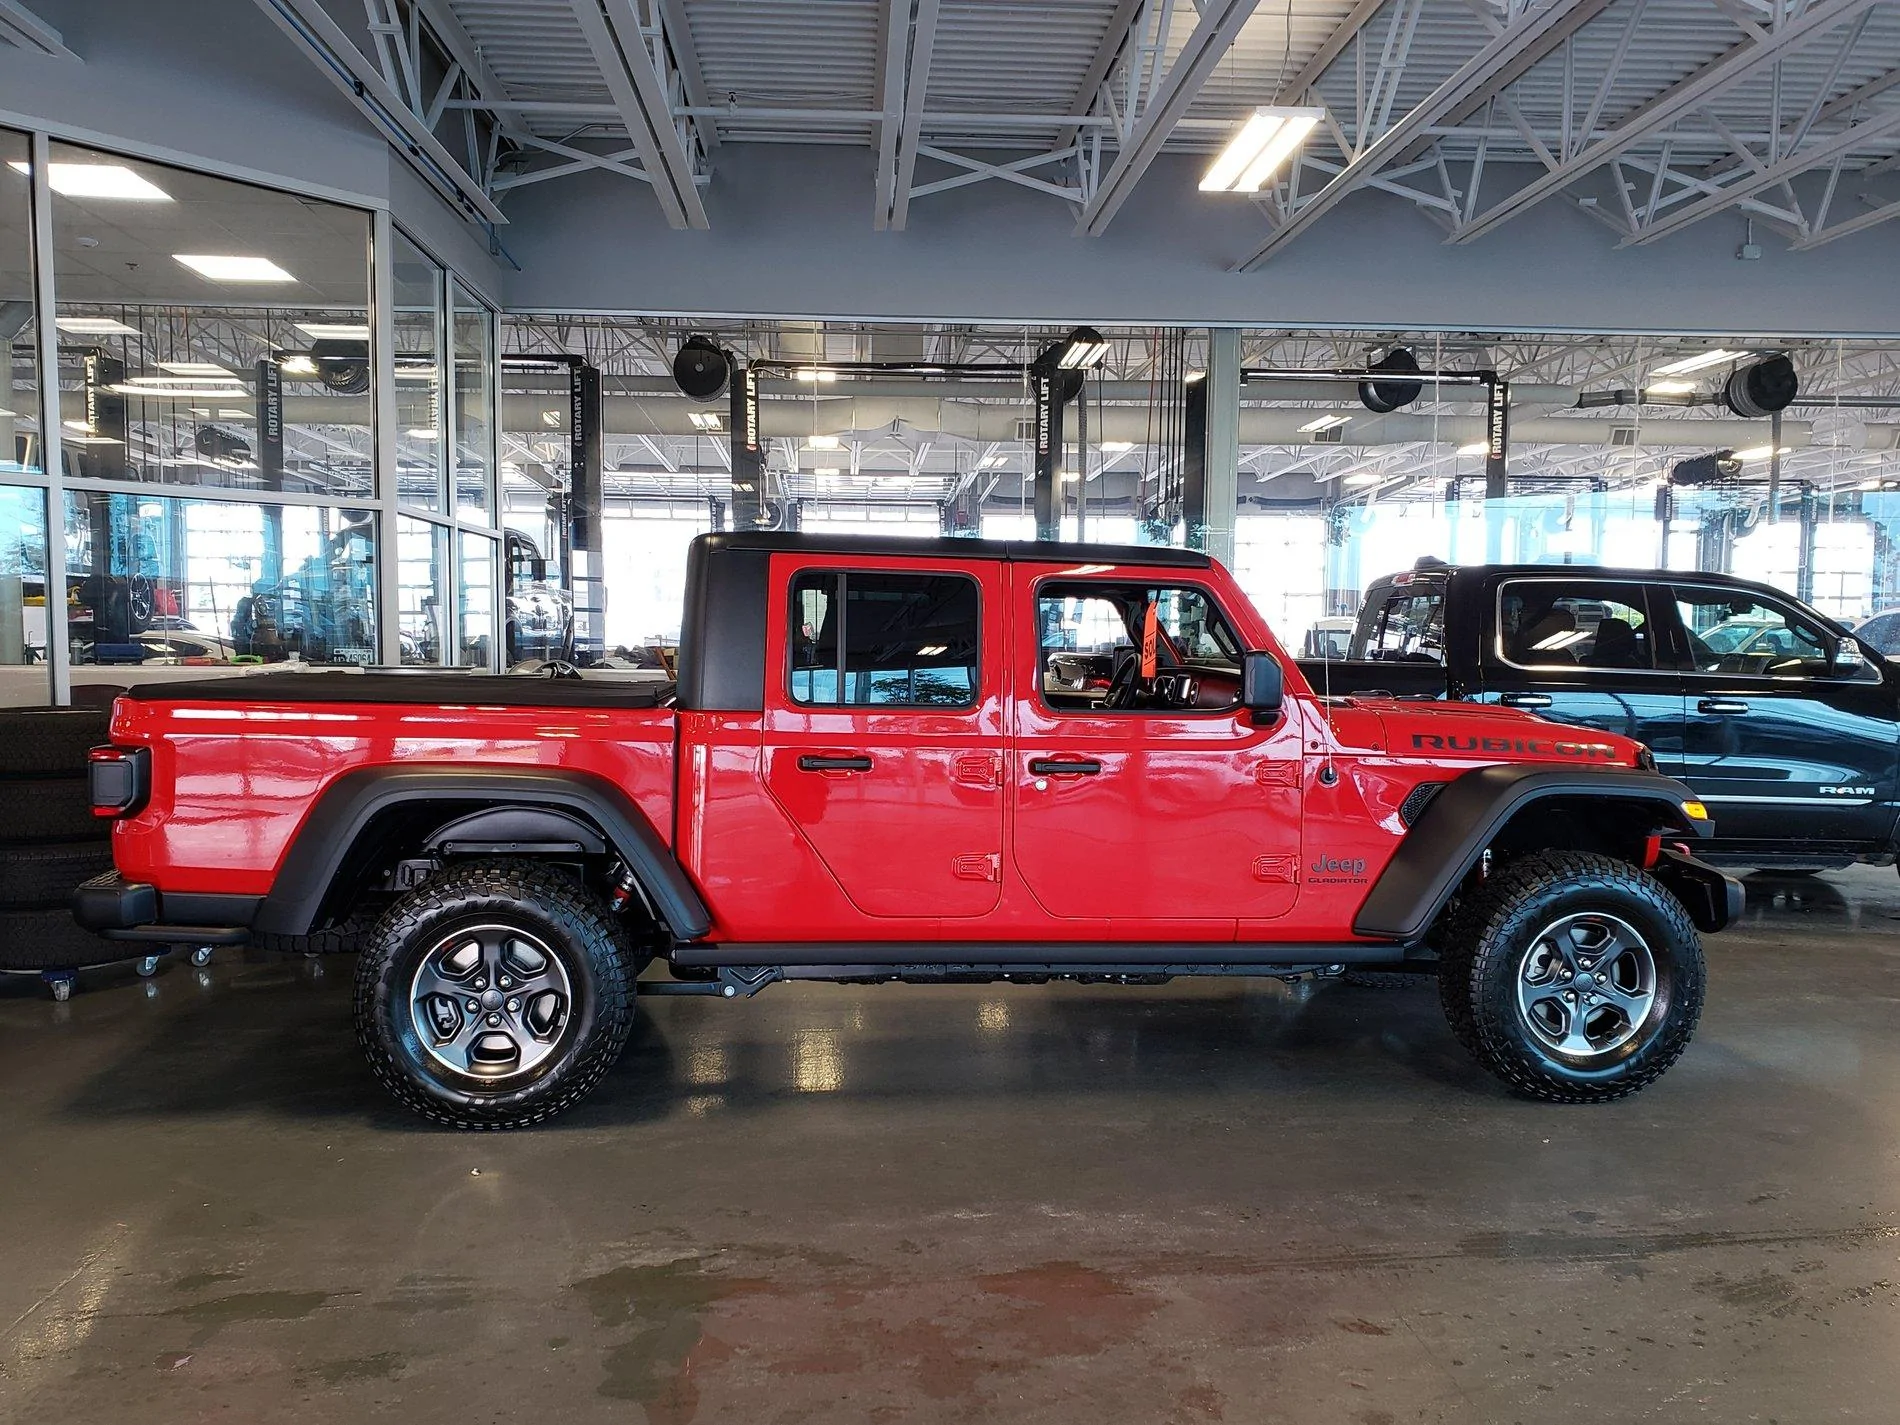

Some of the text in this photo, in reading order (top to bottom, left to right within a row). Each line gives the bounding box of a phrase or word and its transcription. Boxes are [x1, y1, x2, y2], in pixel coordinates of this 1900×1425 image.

[268, 362, 278, 436] ROTARY LIFT
[574, 368, 582, 441] ROTARY LIFT
[746, 371, 756, 444] ROTARY LIFT
[1040, 377, 1050, 449] ROTARY LIFT
[1492, 383, 1504, 454] ROTARY LIFT
[1411, 734, 1617, 759] RUBICON
[1819, 786, 1875, 795] RAM
[1311, 854, 1367, 876] Jeep
